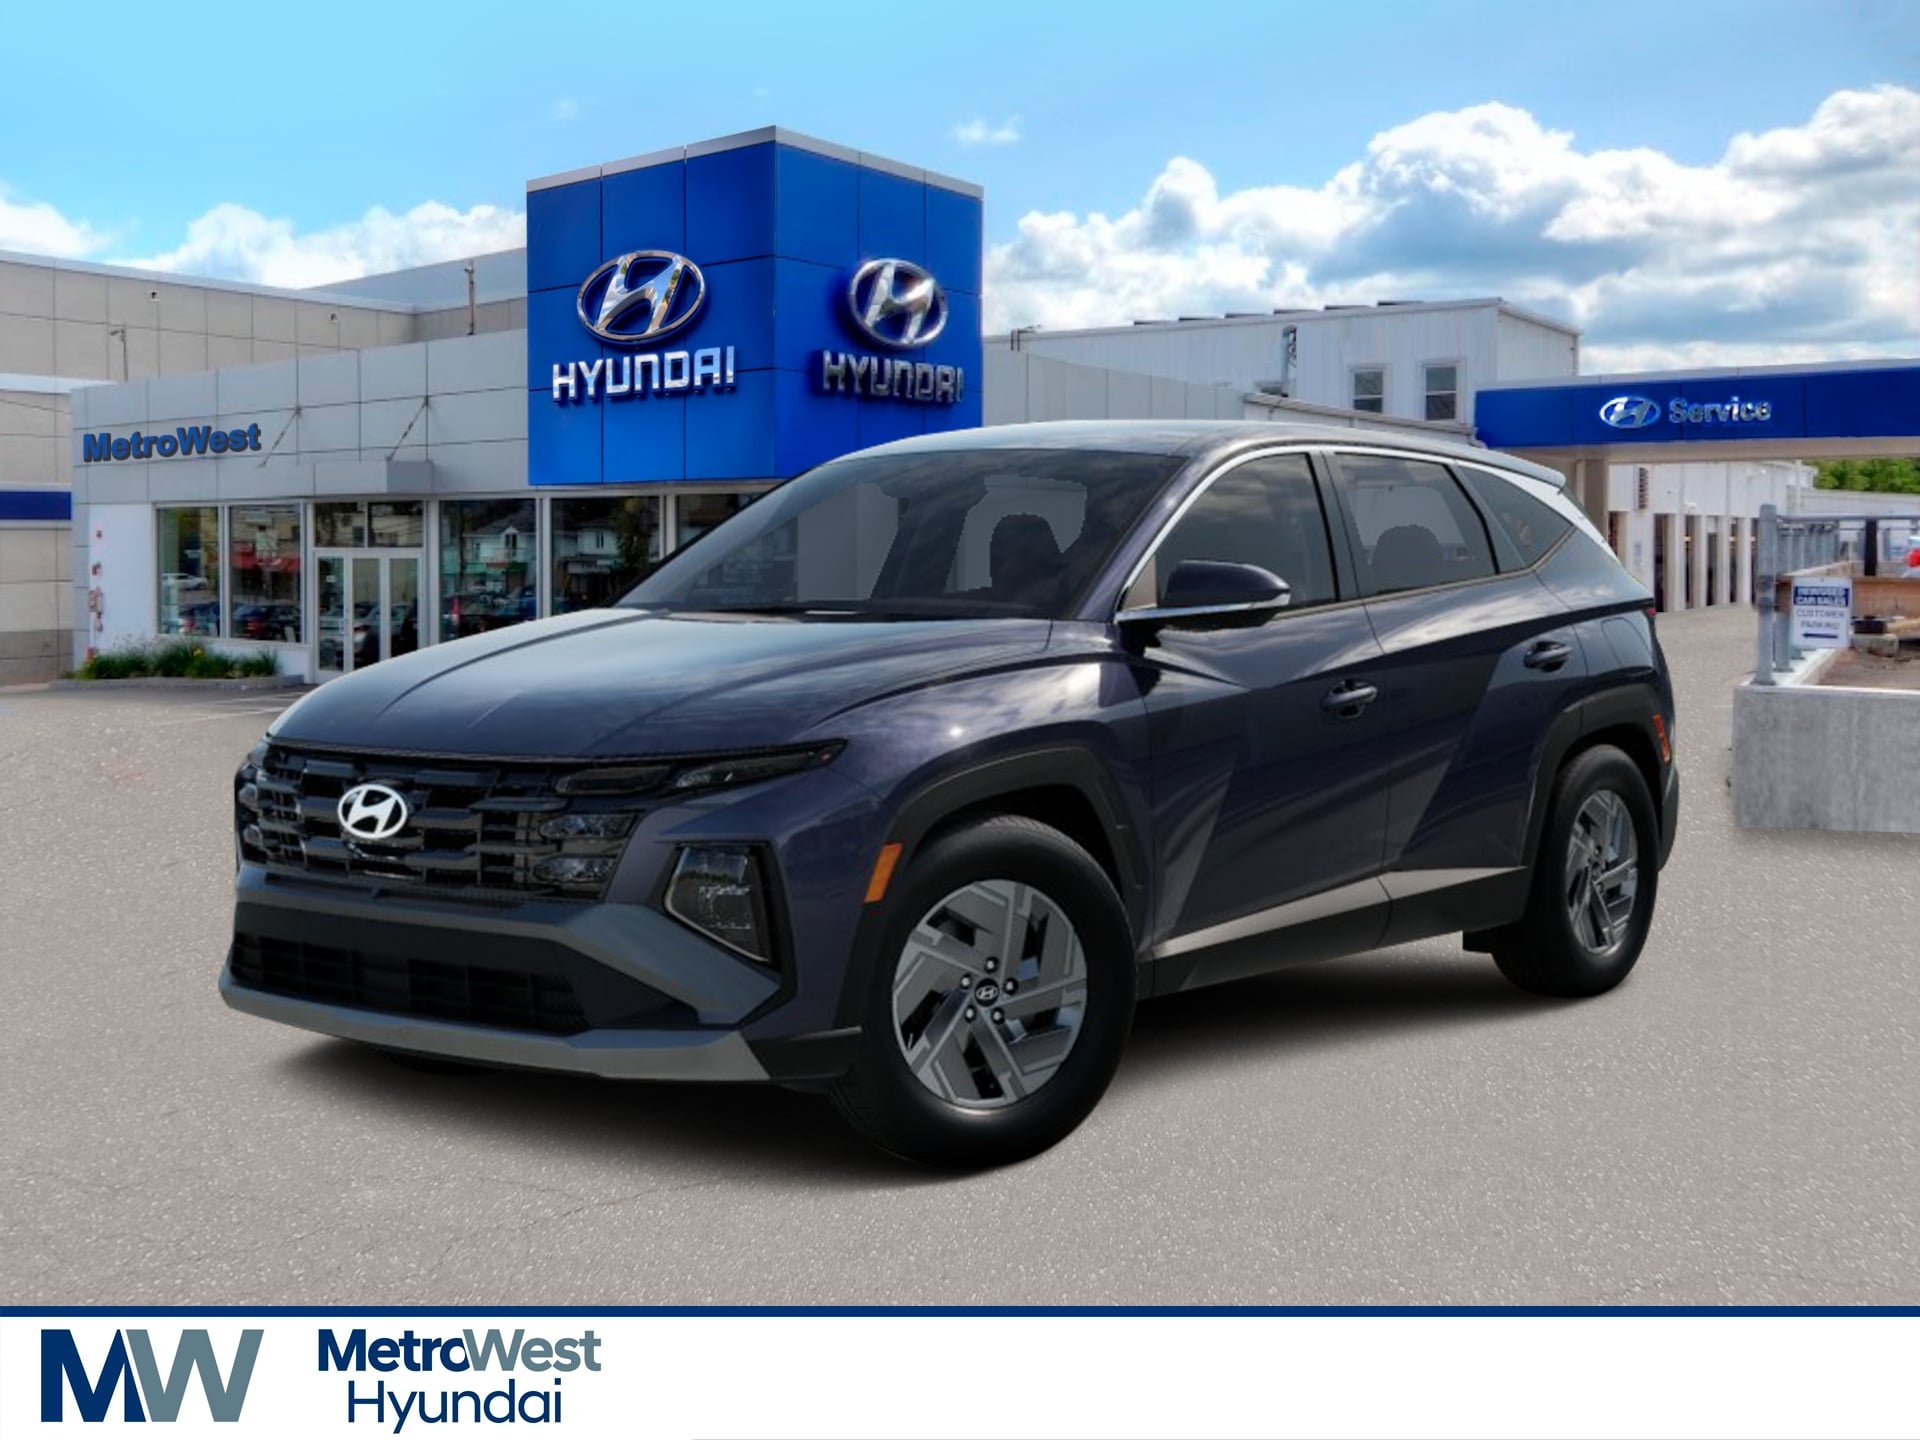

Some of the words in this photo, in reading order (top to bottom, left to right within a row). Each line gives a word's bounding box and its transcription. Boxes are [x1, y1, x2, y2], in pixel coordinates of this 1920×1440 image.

[552, 345, 735, 401] HYUNDAI
[822, 350, 965, 403] HYUNDAI
[1668, 396, 1772, 424] Service
[83, 423, 262, 463] MetroWest
